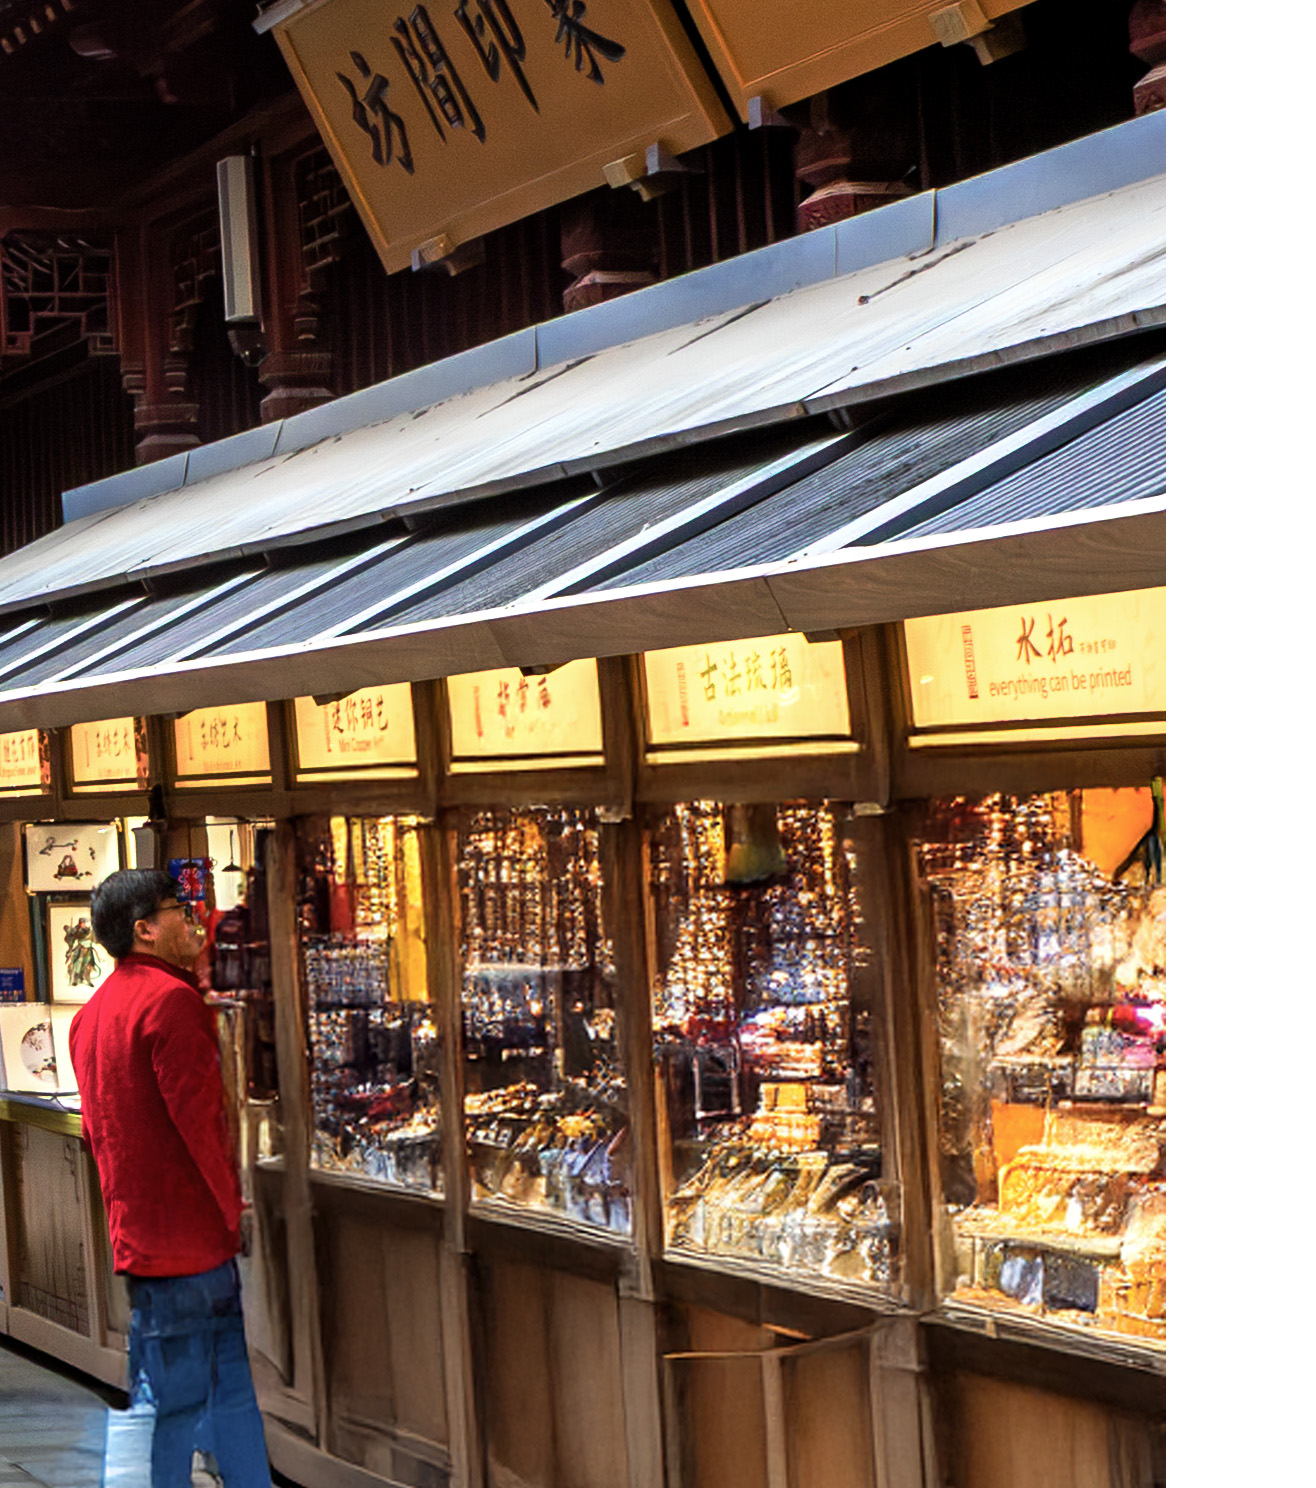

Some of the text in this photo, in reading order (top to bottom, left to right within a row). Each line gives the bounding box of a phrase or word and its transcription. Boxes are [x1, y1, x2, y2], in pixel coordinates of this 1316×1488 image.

[1016, 614, 1074, 665] 水拓
[700, 646, 793, 702] 古法琉璃
[989, 664, 1132, 699] everything can be printed
